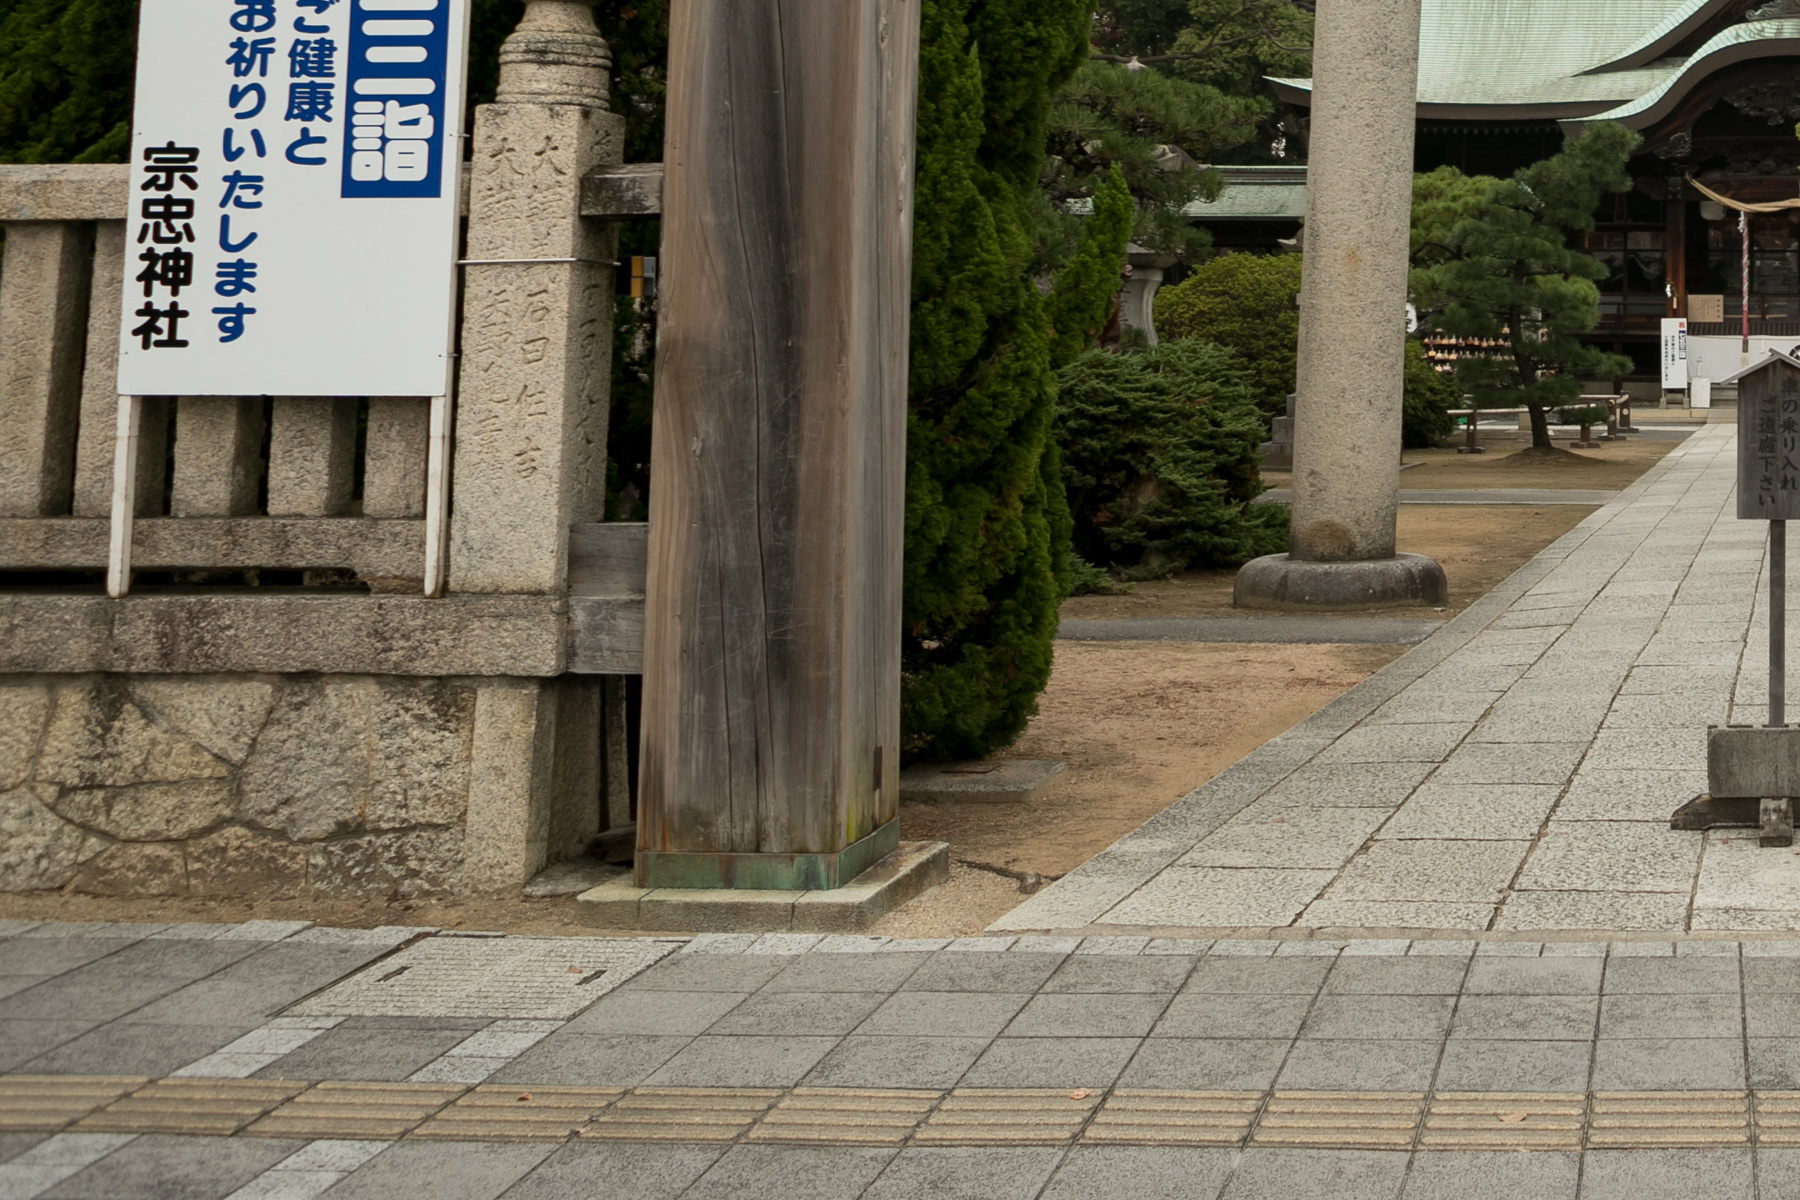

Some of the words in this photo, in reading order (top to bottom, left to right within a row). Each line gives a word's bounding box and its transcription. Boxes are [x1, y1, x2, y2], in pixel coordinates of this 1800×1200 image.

[131, 140, 201, 351] 宗忠神社
[1757, 396, 1778, 507] ご遠慮下さい
[1779, 376, 1800, 492] 車の乗り入れ
